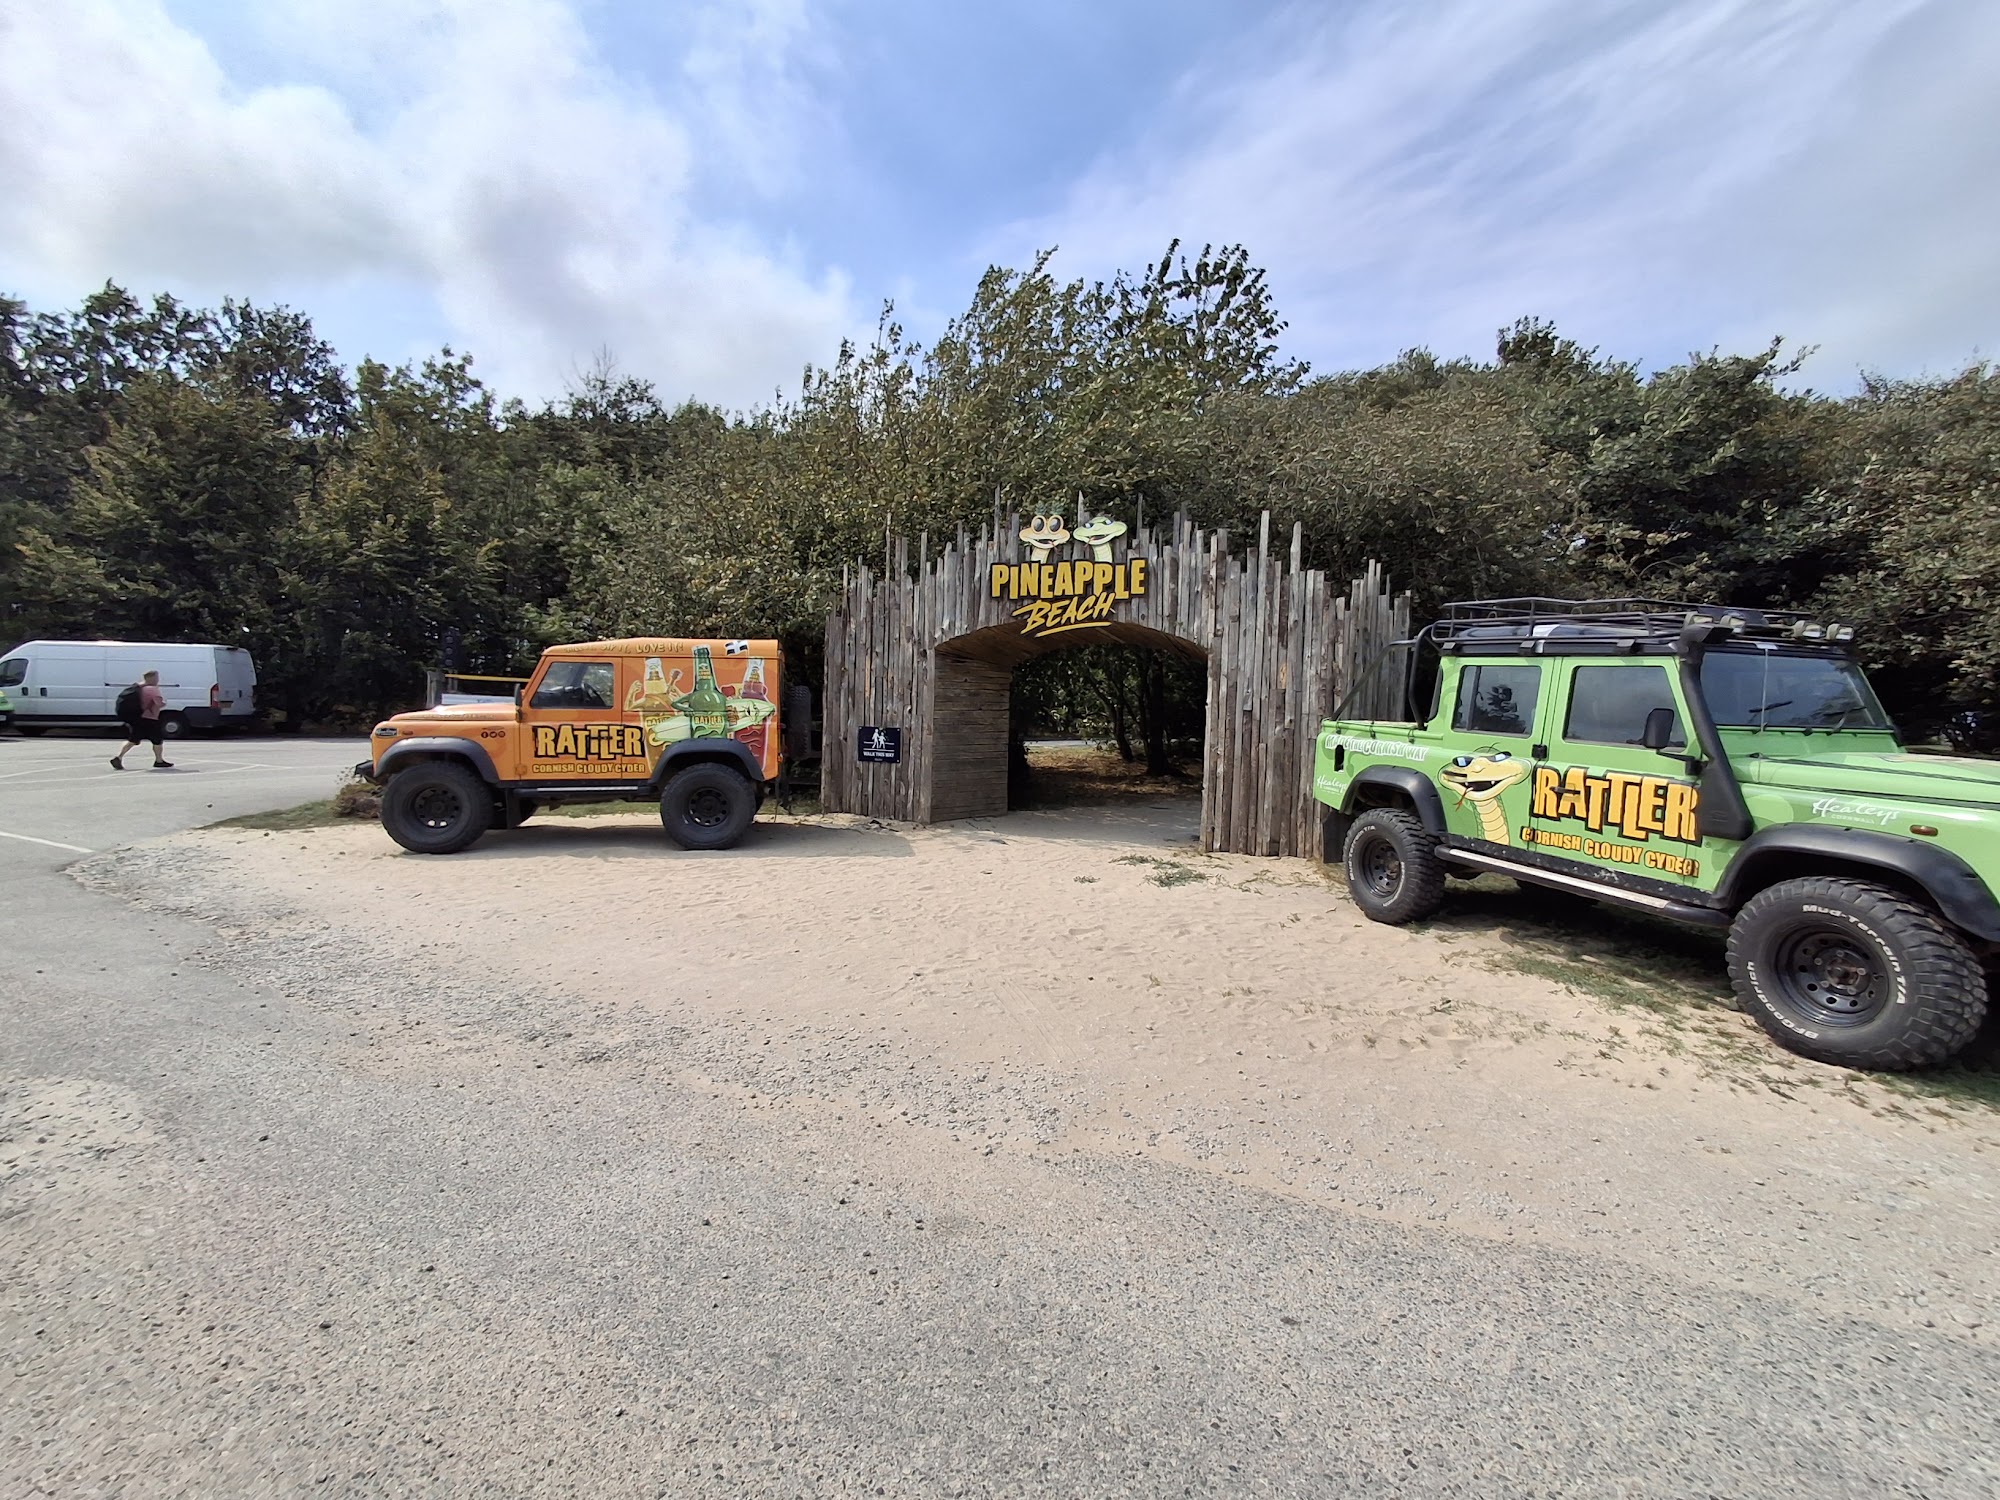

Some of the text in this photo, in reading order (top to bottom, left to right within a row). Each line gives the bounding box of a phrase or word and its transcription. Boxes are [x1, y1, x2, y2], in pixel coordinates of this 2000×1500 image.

[991, 559, 1147, 600] PINEAPPLE
[1012, 592, 1116, 635] BEACH
[636, 642, 665, 654] LOVE
[668, 642, 684, 653] IT!
[694, 715, 723, 725] RATTLER
[534, 724, 645, 760] RATTLER
[1362, 739, 1405, 757] CORNISH
[1405, 745, 1429, 761] WAY
[532, 763, 645, 774] CORNISH CLOUDY CYDER
[1532, 766, 1699, 843] RATTLER
[1812, 797, 1899, 825] Healeys
[1521, 826, 1582, 851] CORNISH
[1583, 838, 1644, 864] CLOUDY
[1802, 904, 1907, 1004] Mud-Terrain T/A
[1747, 961, 1820, 1040] BFGoodrich
